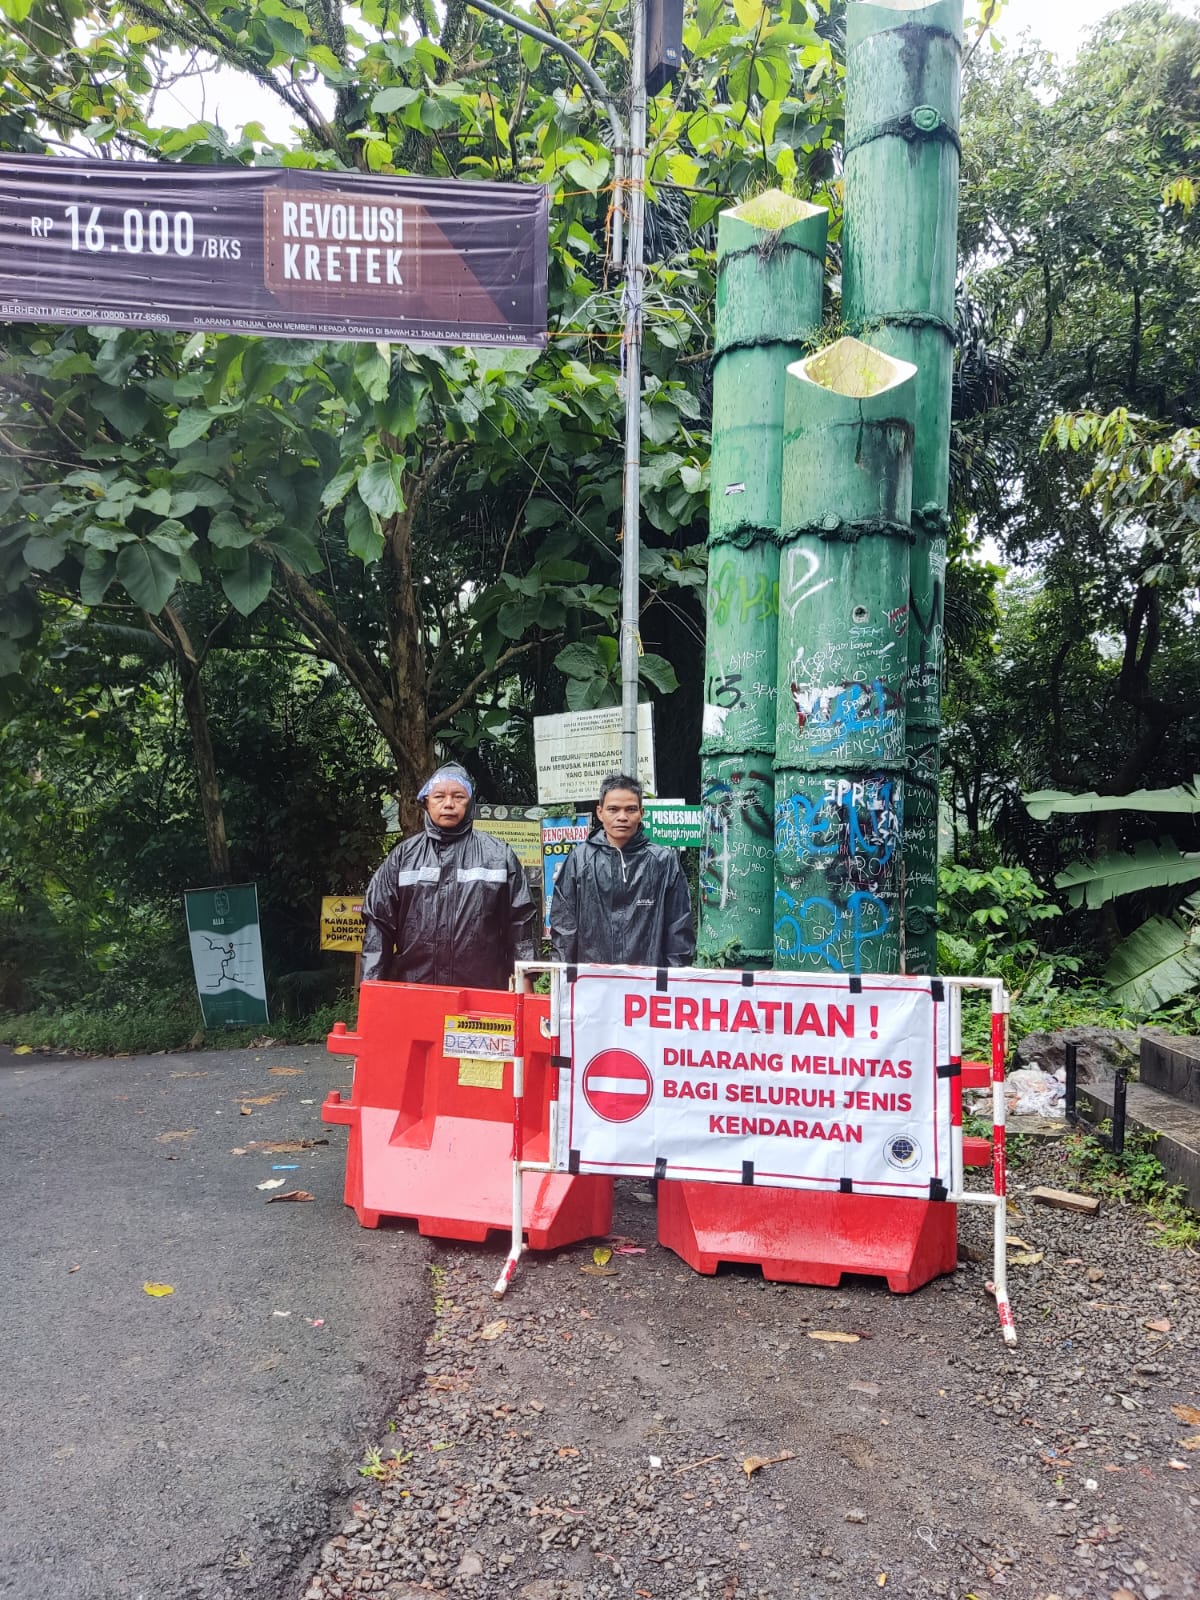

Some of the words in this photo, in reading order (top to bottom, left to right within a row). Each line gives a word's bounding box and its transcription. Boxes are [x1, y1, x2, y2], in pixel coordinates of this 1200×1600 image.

[31, 216, 54, 238] RP
[64, 206, 194, 256] 16.000
[202, 238, 242, 260] /BKS
[282, 202, 403, 243] REVOLUSI
[283, 244, 404, 285] KRETEK
[2, 304, 49, 316] BERHENTI
[52, 308, 100, 318] MEROKOK
[194, 316, 232, 326] DILARANG
[232, 319, 266, 329] MENJUAL
[267, 321, 284, 330] DAN
[284, 322, 318, 332] MEMBERI
[318, 325, 346, 333] KEPADA
[348, 326, 374, 334] ORANG
[384, 328, 410, 336] BAWAH
[420, 330, 444, 338] TAHUN
[462, 332, 505, 341] PEREMPUAN
[506, 334, 528, 342] HAMIL
[552, 762, 581, 770] MERUSAK
[582, 760, 609, 768] HABITAT
[652, 810, 702, 825] PUSKESMAS
[543, 826, 589, 842] PENGINAPAN
[624, 994, 854, 1038] PERHATIAN
[663, 1048, 783, 1072] DILARANG
[792, 1054, 912, 1079] MELINTAS
[663, 1080, 718, 1101] BAGI
[725, 1083, 836, 1108] SELURUH
[843, 1090, 912, 1112] JENIS
[709, 1114, 863, 1144] KENDARAAN
